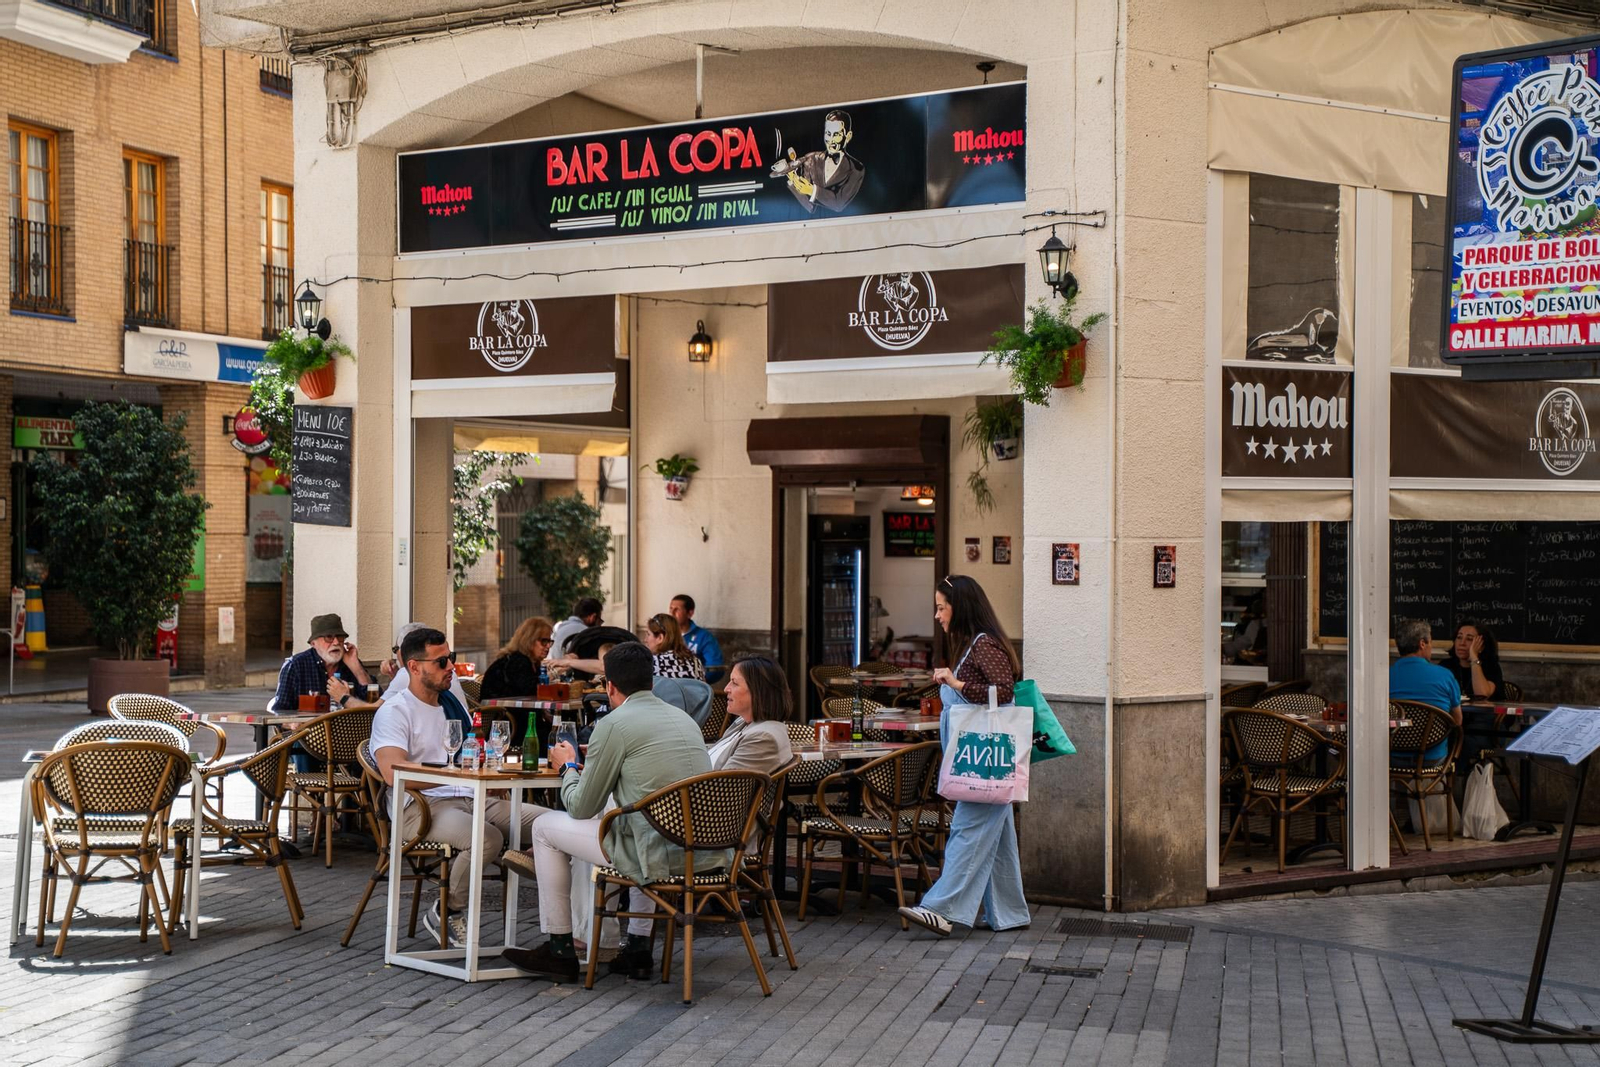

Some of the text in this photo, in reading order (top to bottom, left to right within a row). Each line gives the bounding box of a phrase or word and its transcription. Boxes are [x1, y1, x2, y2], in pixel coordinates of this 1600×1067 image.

[1482, 84, 1550, 145] Coffee
[953, 127, 1024, 153] Mahou
[547, 126, 762, 186] BAR LA COPA
[420, 183, 473, 205] Mahou
[550, 184, 693, 214] SUS CAFES SIN IGUAL
[1490, 180, 1592, 228] Marina
[620, 198, 759, 228] SUS VINOS SIN RIVAL
[1464, 238, 1600, 266] PARQUE DE BOL
[1463, 264, 1600, 290] Y CELEBRACION
[847, 307, 949, 327] BAR LA COPA
[1460, 294, 1600, 317] EVENTOS DESAYUN
[469, 334, 548, 350] BAR LA COPA
[1451, 327, 1506, 350] CALLE
[1507, 323, 1586, 347] MARINA,
[1230, 381, 1348, 429] Mahou
[297, 408, 347, 432] MENU 10€
[1529, 437, 1596, 453] BAR LA COPA
[914, 515, 930, 531] LA
[957, 744, 1012, 767] AVRIL
